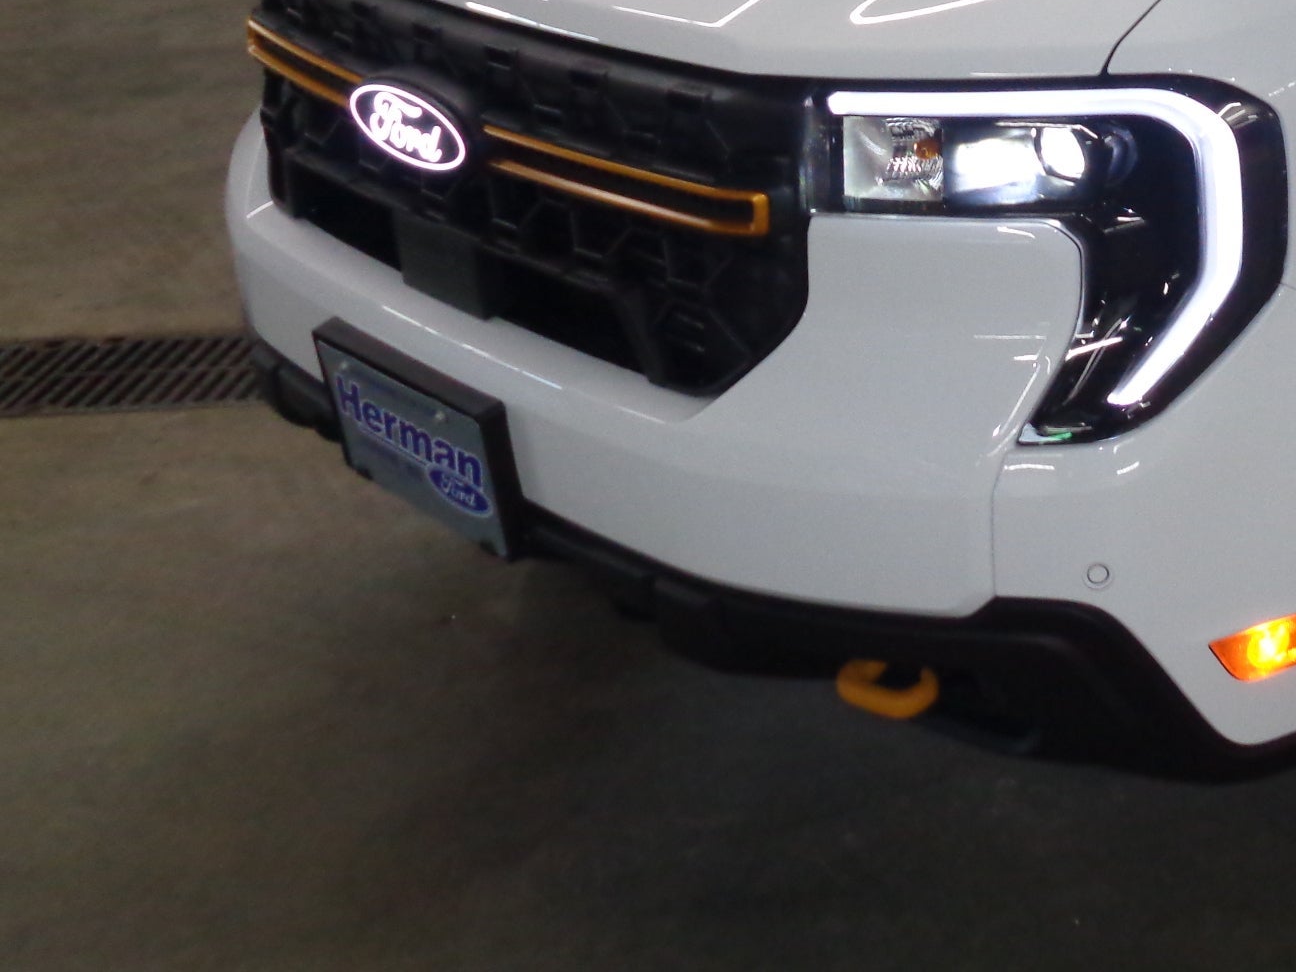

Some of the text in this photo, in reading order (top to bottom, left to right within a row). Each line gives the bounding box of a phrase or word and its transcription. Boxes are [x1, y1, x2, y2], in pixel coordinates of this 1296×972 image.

[368, 90, 444, 164] Ford
[335, 375, 483, 490] Herman
[438, 471, 478, 509] Ford
